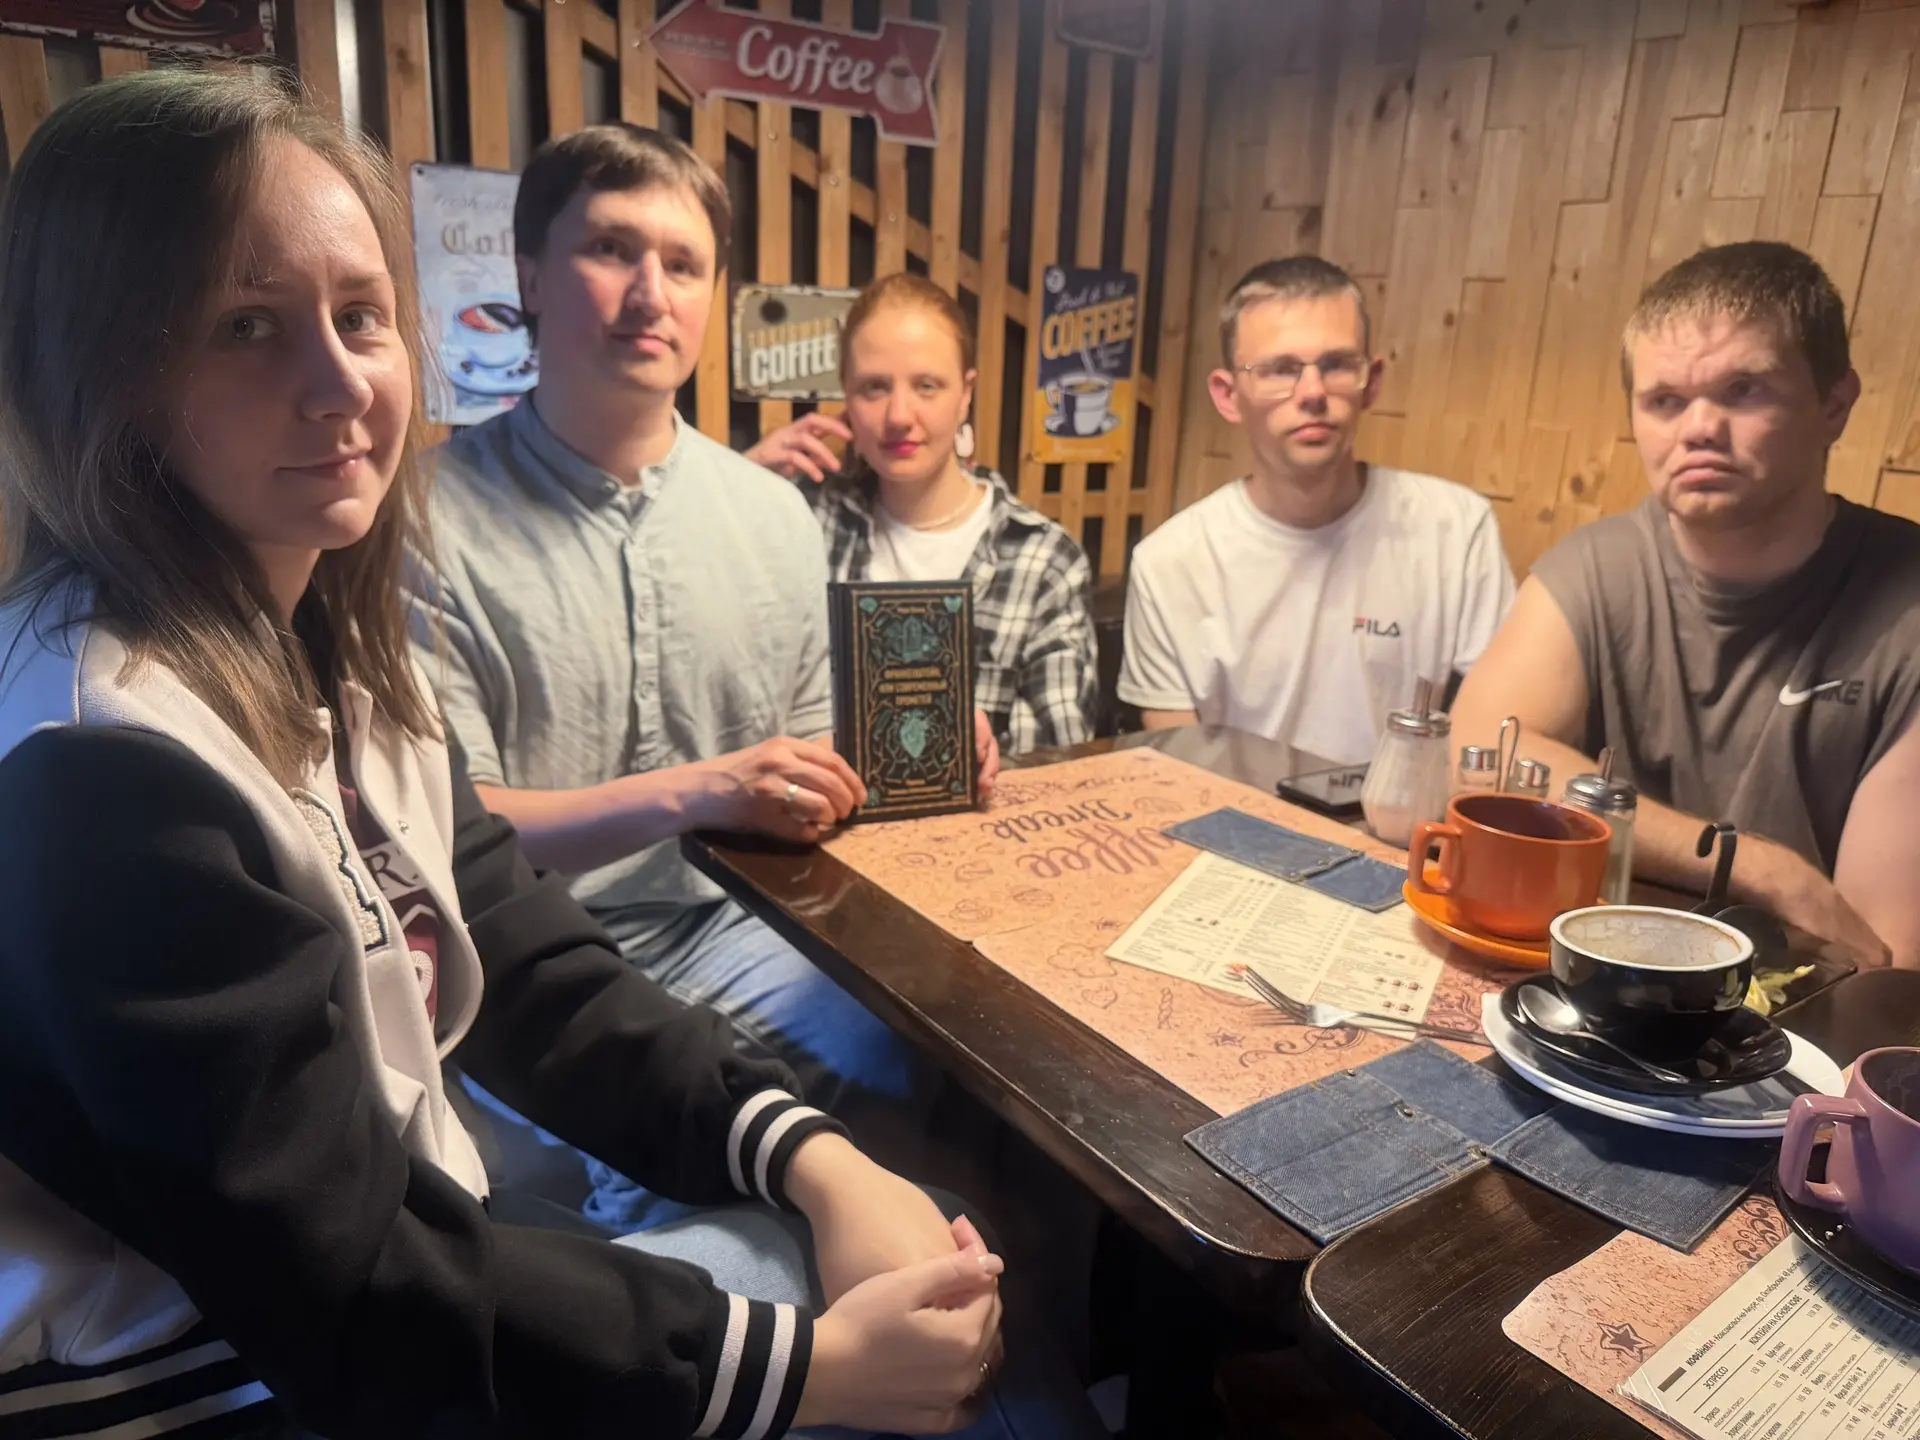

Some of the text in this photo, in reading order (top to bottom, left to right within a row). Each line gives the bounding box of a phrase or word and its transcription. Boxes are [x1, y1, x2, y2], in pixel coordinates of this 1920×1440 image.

[736, 24, 876, 96] Coffee
[1042, 295, 1135, 361] COFFEE
[749, 332, 838, 388] COFFEE
[1352, 616, 1401, 639] FILA
[980, 797, 1134, 843] Break
[1016, 820, 1178, 878] offee
[1748, 1322, 1773, 1345] КОКТЕЙЛИ
[1768, 1316, 1778, 1328] НА
[1773, 1302, 1793, 1322] ОСНОВЕ
[1787, 1294, 1802, 1308] КОФЕ
[1703, 1365, 1729, 1389] ЭСПРЕССО
